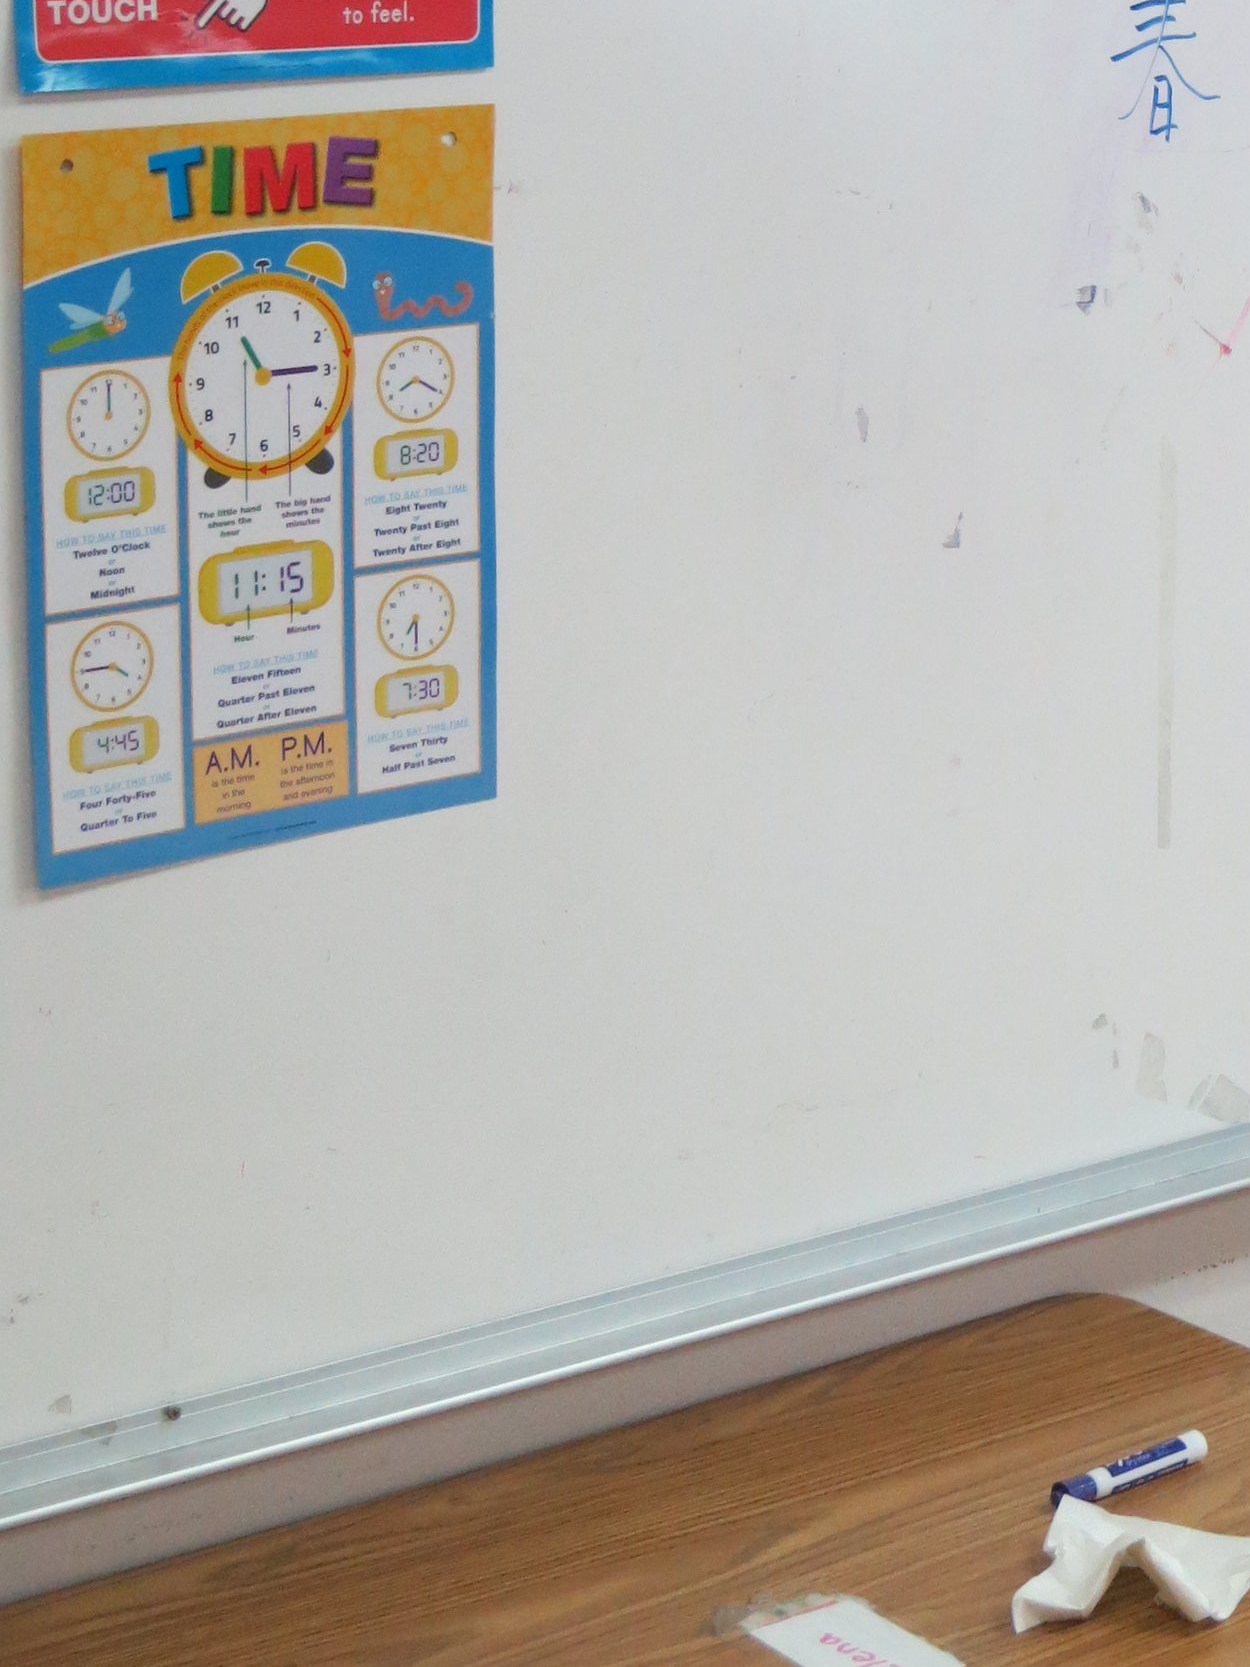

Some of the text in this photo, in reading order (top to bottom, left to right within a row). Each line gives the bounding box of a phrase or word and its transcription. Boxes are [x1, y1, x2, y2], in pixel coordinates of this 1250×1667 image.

[343, 0, 415, 24] to feel.
[147, 136, 379, 220] TIME
[256, 301, 271, 314] 12
[225, 316, 239, 328] 11
[293, 310, 300, 322] 1
[314, 331, 321, 343] 2
[204, 342, 220, 355] 10
[323, 364, 331, 376] 3
[196, 378, 205, 390] 9
[314, 396, 322, 408] 4
[205, 409, 213, 422] 8
[293, 425, 300, 437] 5
[229, 433, 236, 445] 7
[260, 439, 268, 452] 6
[400, 441, 440, 465] 8:20
[88, 480, 135, 506] 12:00
[275, 495, 331, 509] The big hand
[385, 500, 447, 515] Eight Twenty
[374, 518, 460, 537] Twenty Past Eight
[73, 542, 151, 559] Twelve O'Clock
[373, 538, 461, 557] Twenty After Eight
[99, 566, 125, 577] Noon
[90, 586, 135, 600] Midnight
[286, 624, 321, 634] Minutes
[234, 634, 255, 643] Hour
[231, 667, 302, 684] Eleven Fifteen
[218, 685, 315, 708] Quarter Past Eleven
[403, 678, 440, 700] 7:30
[216, 705, 317, 729] Quarter After Eleven
[97, 730, 140, 753] 4:45
[281, 731, 332, 761] P.M.
[389, 736, 448, 752] Seven Thirty
[205, 744, 260, 775] A.M.
[382, 755, 456, 774] Half Past Seven
[80, 790, 156, 811] Four Forty-Five
[80, 811, 157, 832] Quarter To Five
